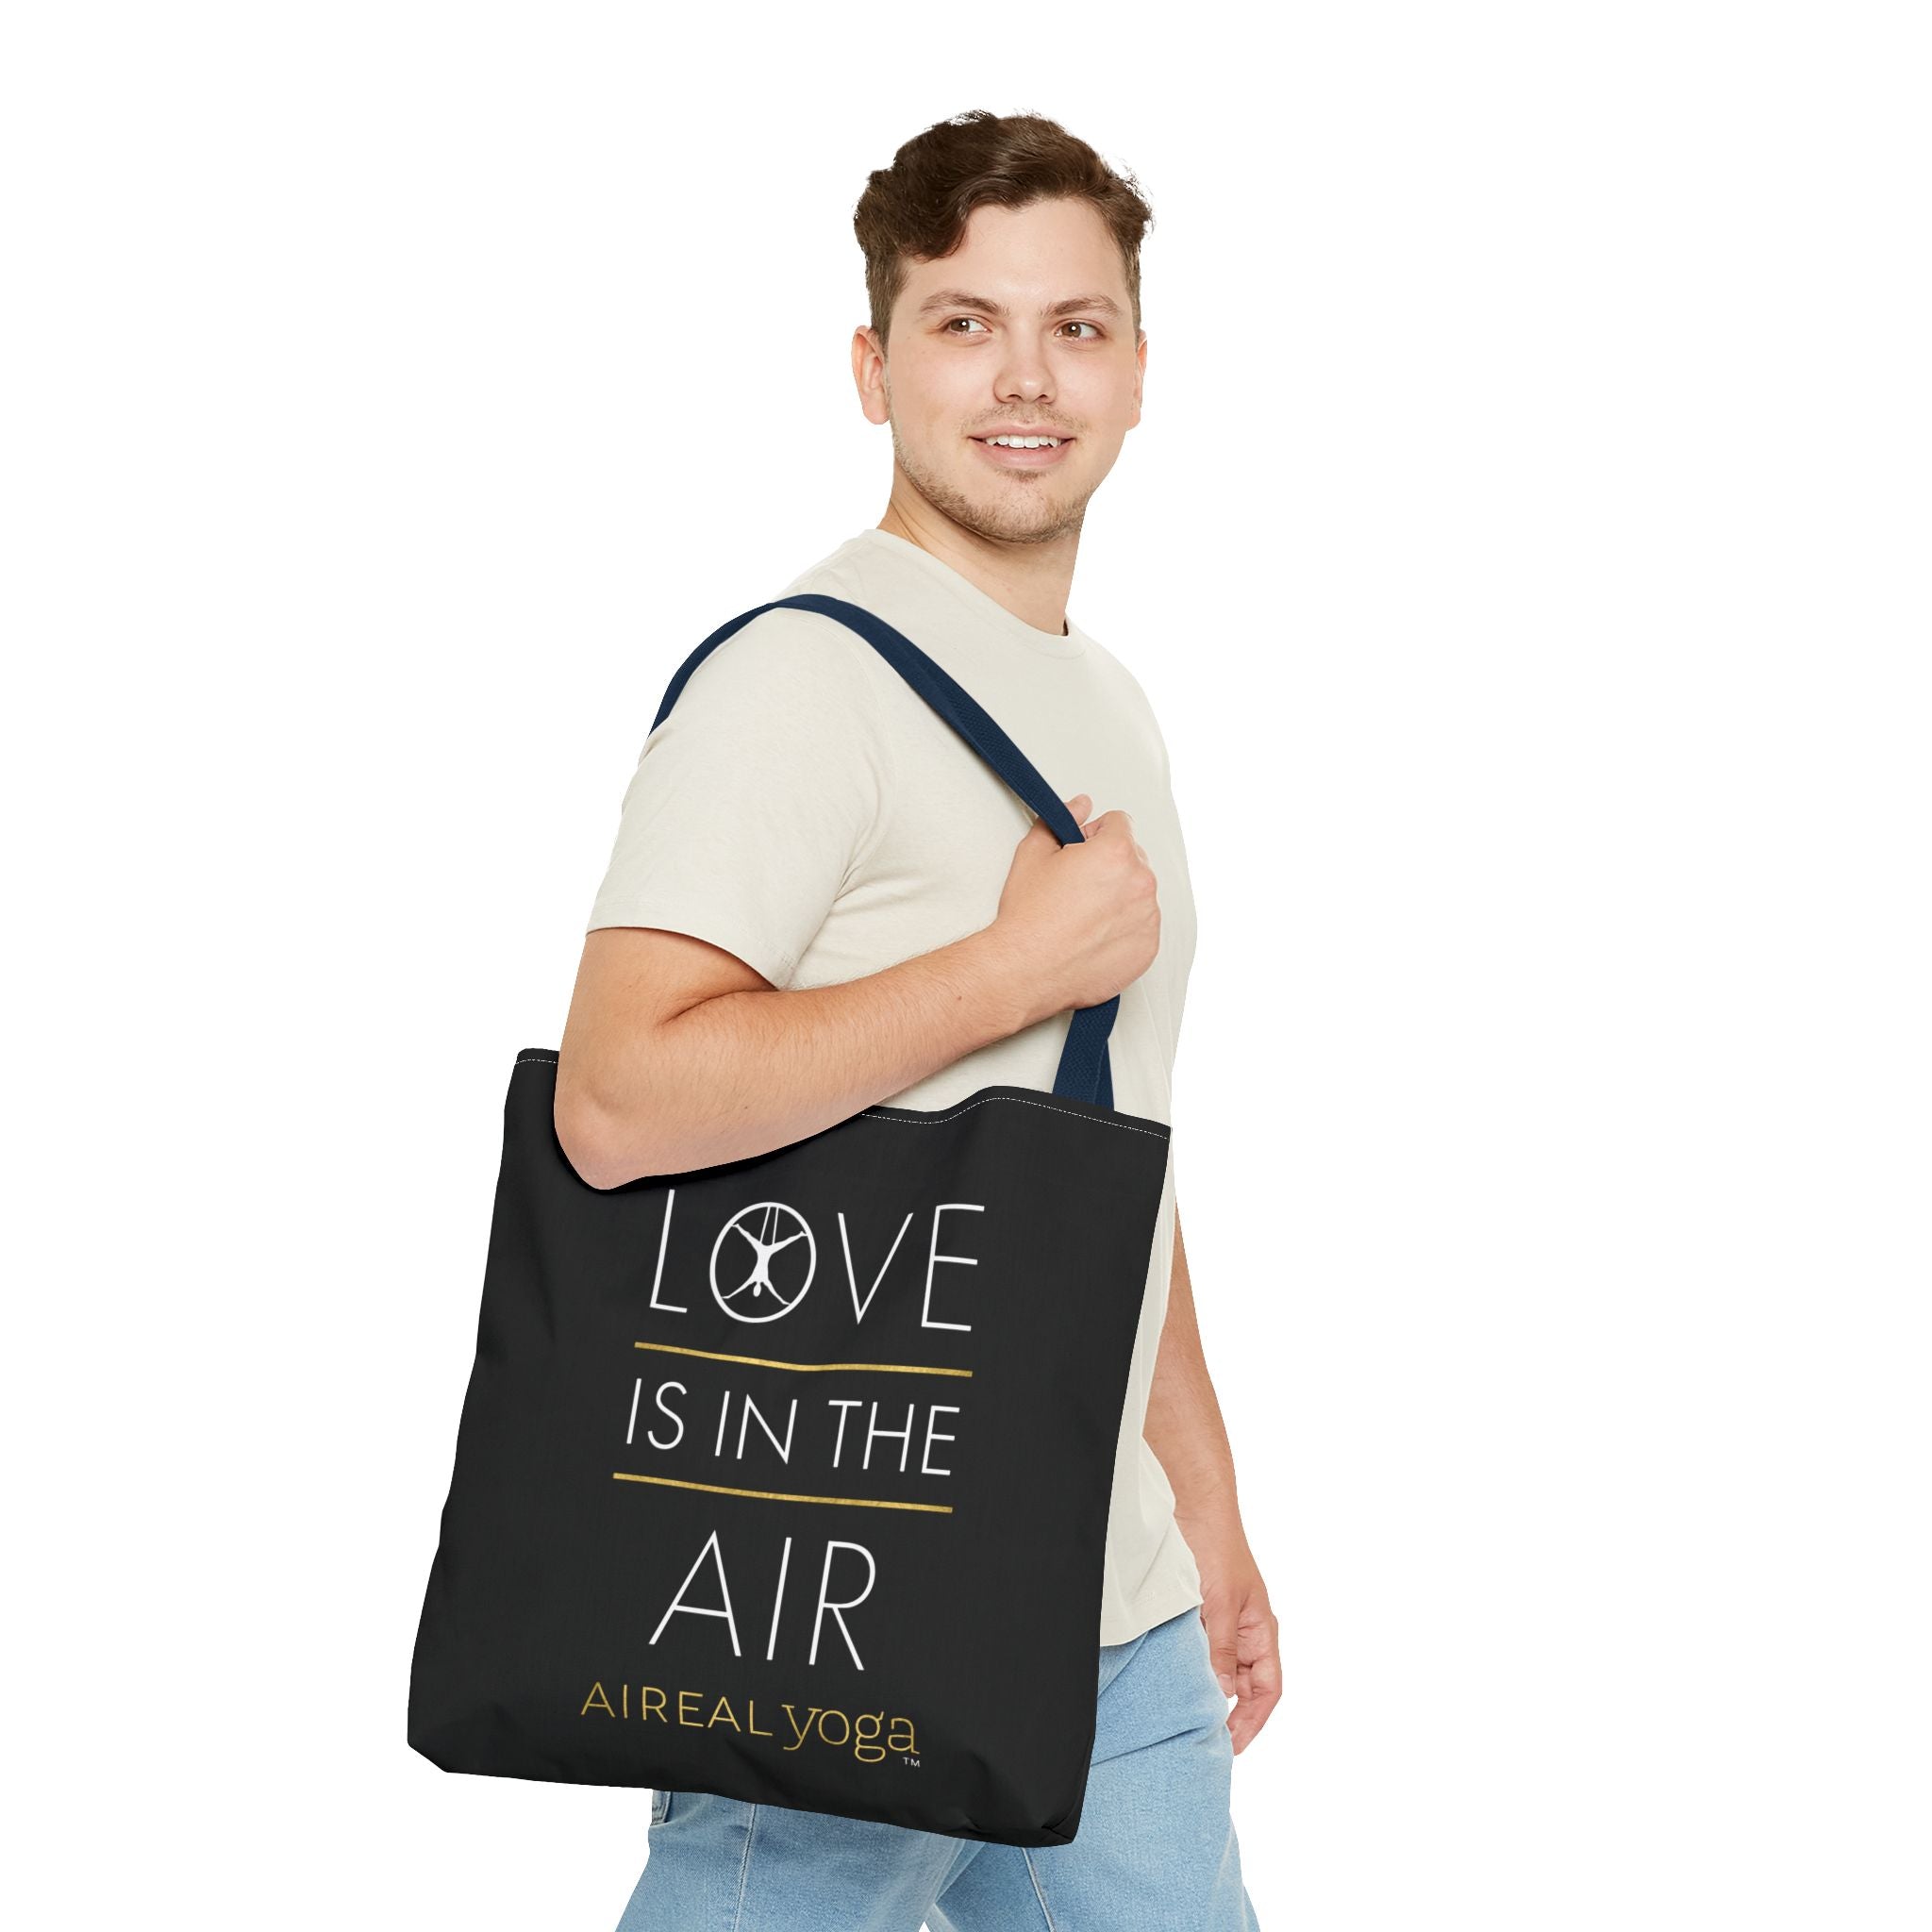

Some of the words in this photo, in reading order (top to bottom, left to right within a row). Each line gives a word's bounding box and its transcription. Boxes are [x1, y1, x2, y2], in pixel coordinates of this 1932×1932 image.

[649, 1189, 986, 1332] LOVE
[625, 1377, 688, 1450] IS
[714, 1390, 798, 1465] IN
[827, 1399, 960, 1476] THE
[648, 1529, 877, 1672] AIR
[580, 1681, 774, 1737] AIREAL
[781, 1703, 921, 1763] yoga
